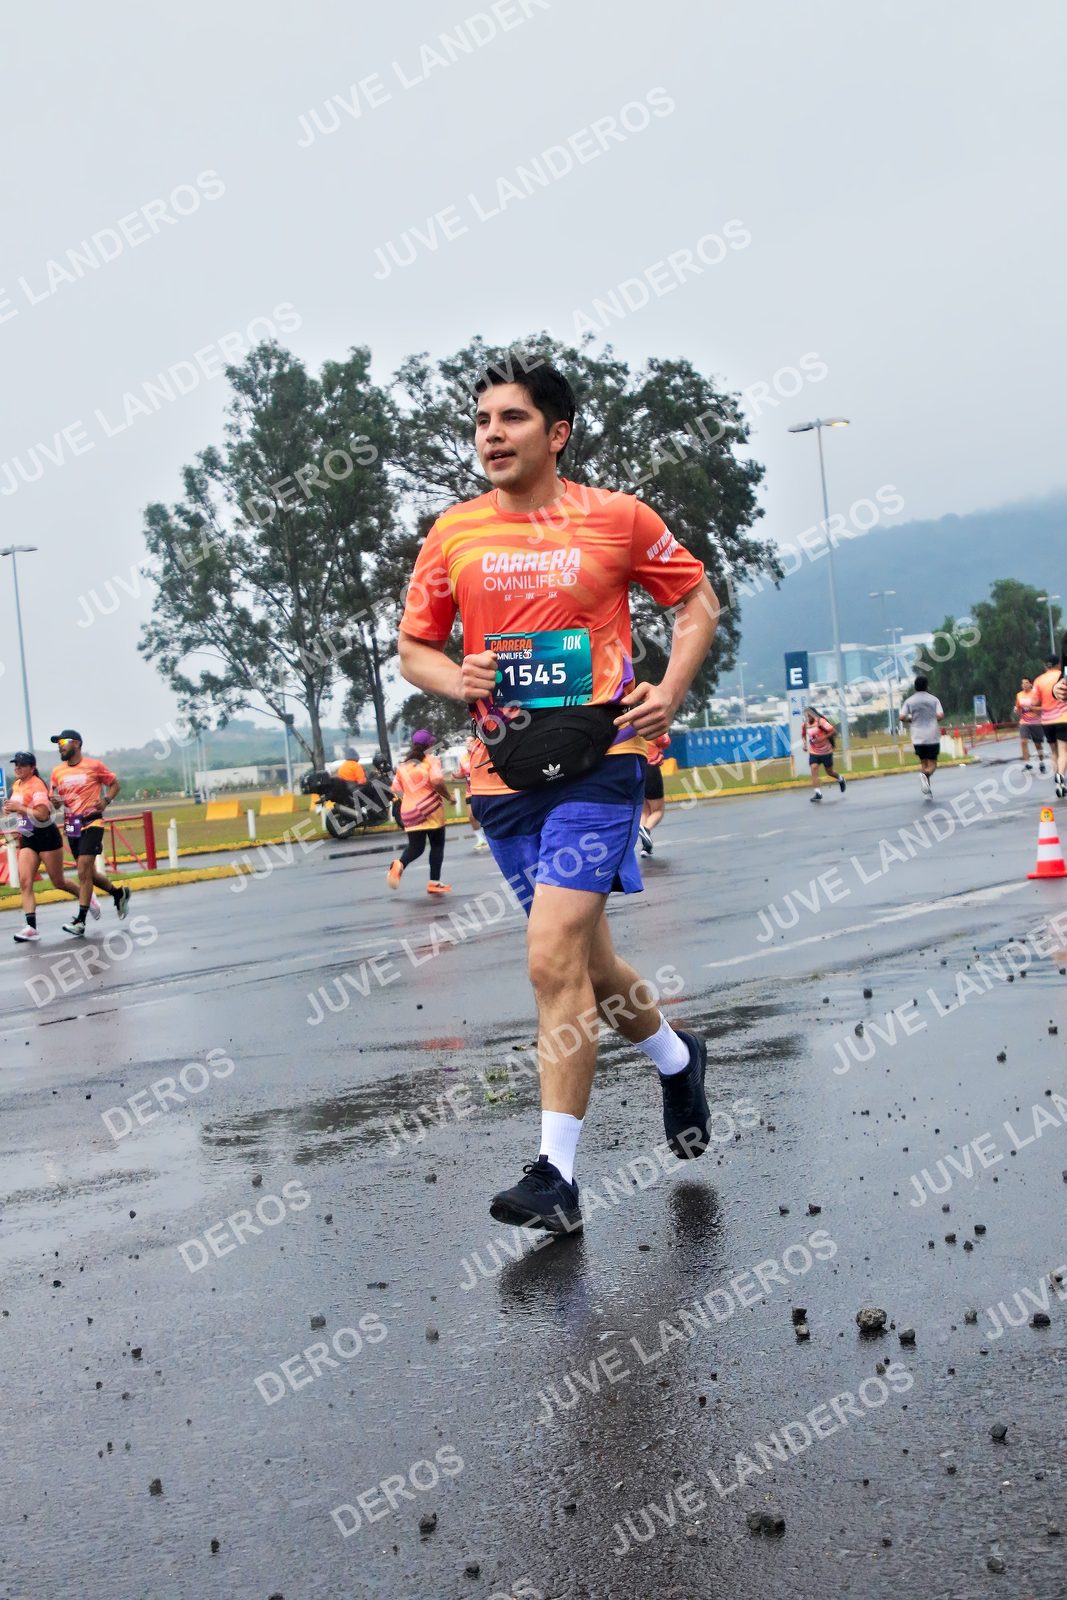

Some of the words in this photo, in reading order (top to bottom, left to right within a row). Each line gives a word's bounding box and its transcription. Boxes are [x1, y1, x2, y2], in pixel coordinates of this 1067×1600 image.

[482, 548, 581, 573] CARRERA
[483, 573, 557, 592] OMNILIFE
[490, 638, 533, 652] CARRERA
[562, 635, 582, 650] 10K
[497, 651, 523, 660] MNILIFE
[504, 663, 567, 686] 1545
[790, 667, 803, 686] E
